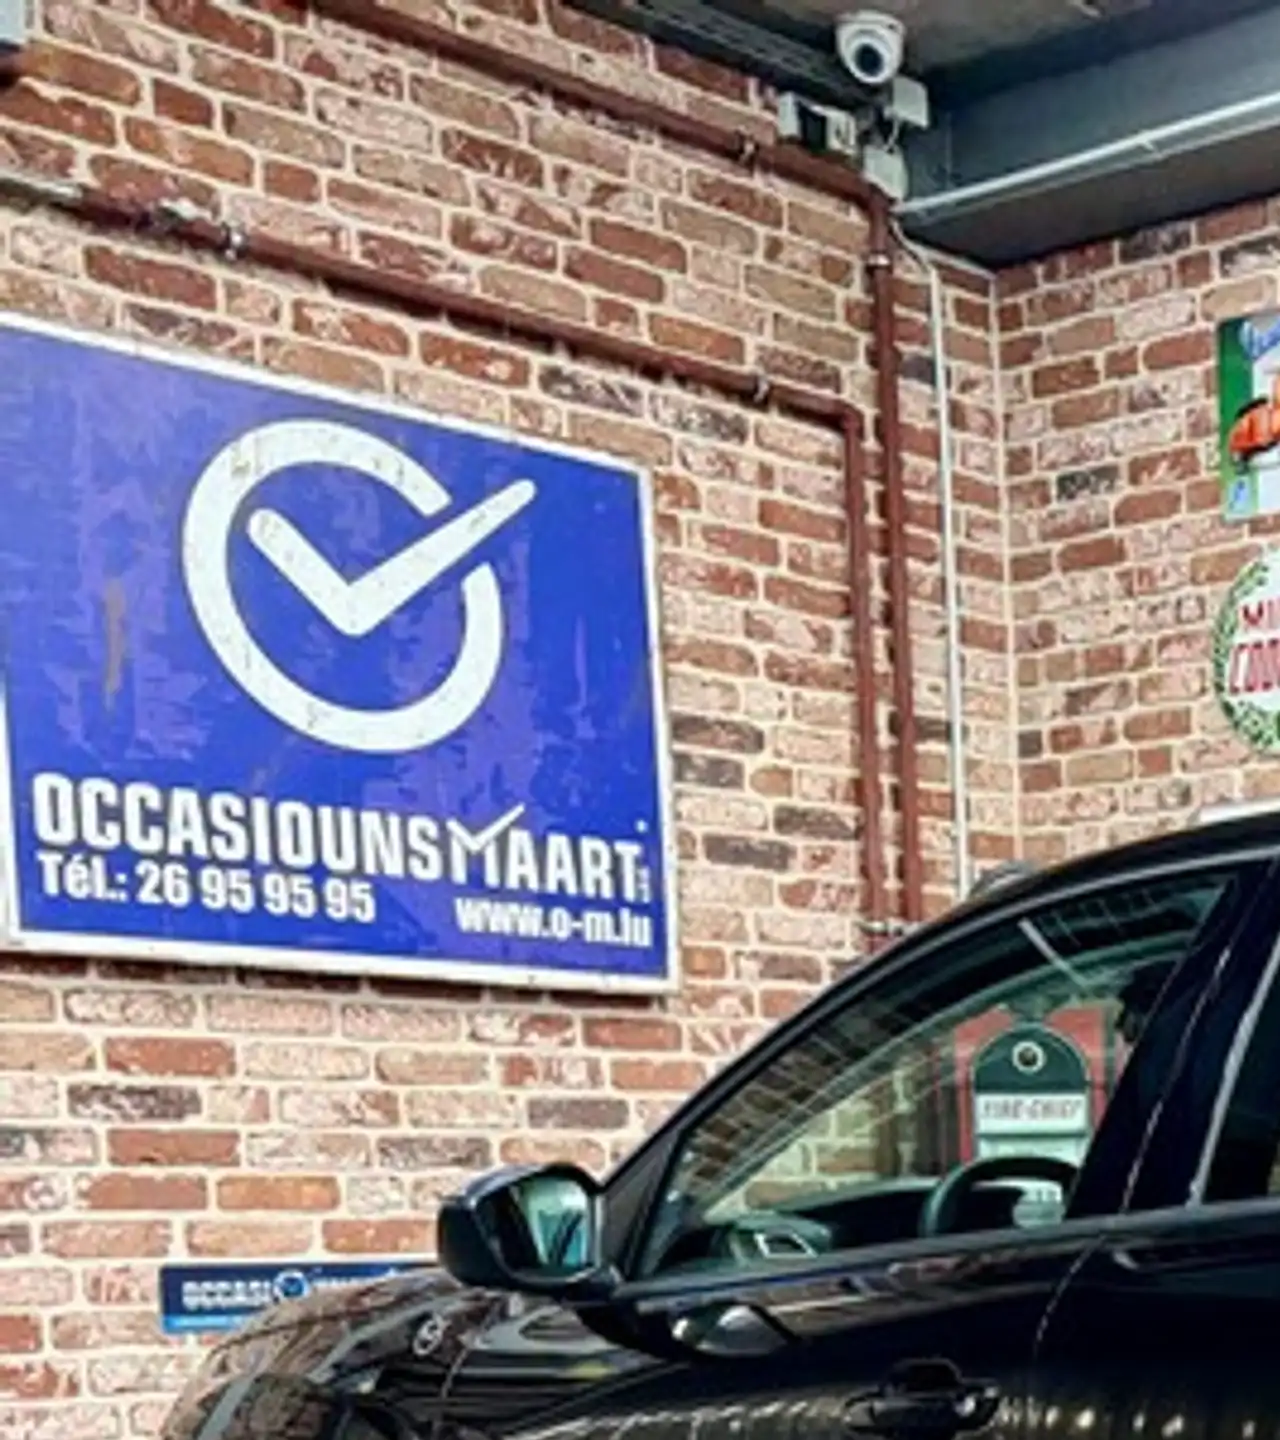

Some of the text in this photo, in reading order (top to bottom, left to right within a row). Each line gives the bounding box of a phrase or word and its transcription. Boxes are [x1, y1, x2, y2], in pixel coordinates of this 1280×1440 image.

[136, 859, 192, 907] 26
[201, 866, 255, 913] 95
[263, 873, 317, 919] 95
[324, 879, 376, 923] 95
[454, 897, 653, 947] www.o-m.lu
